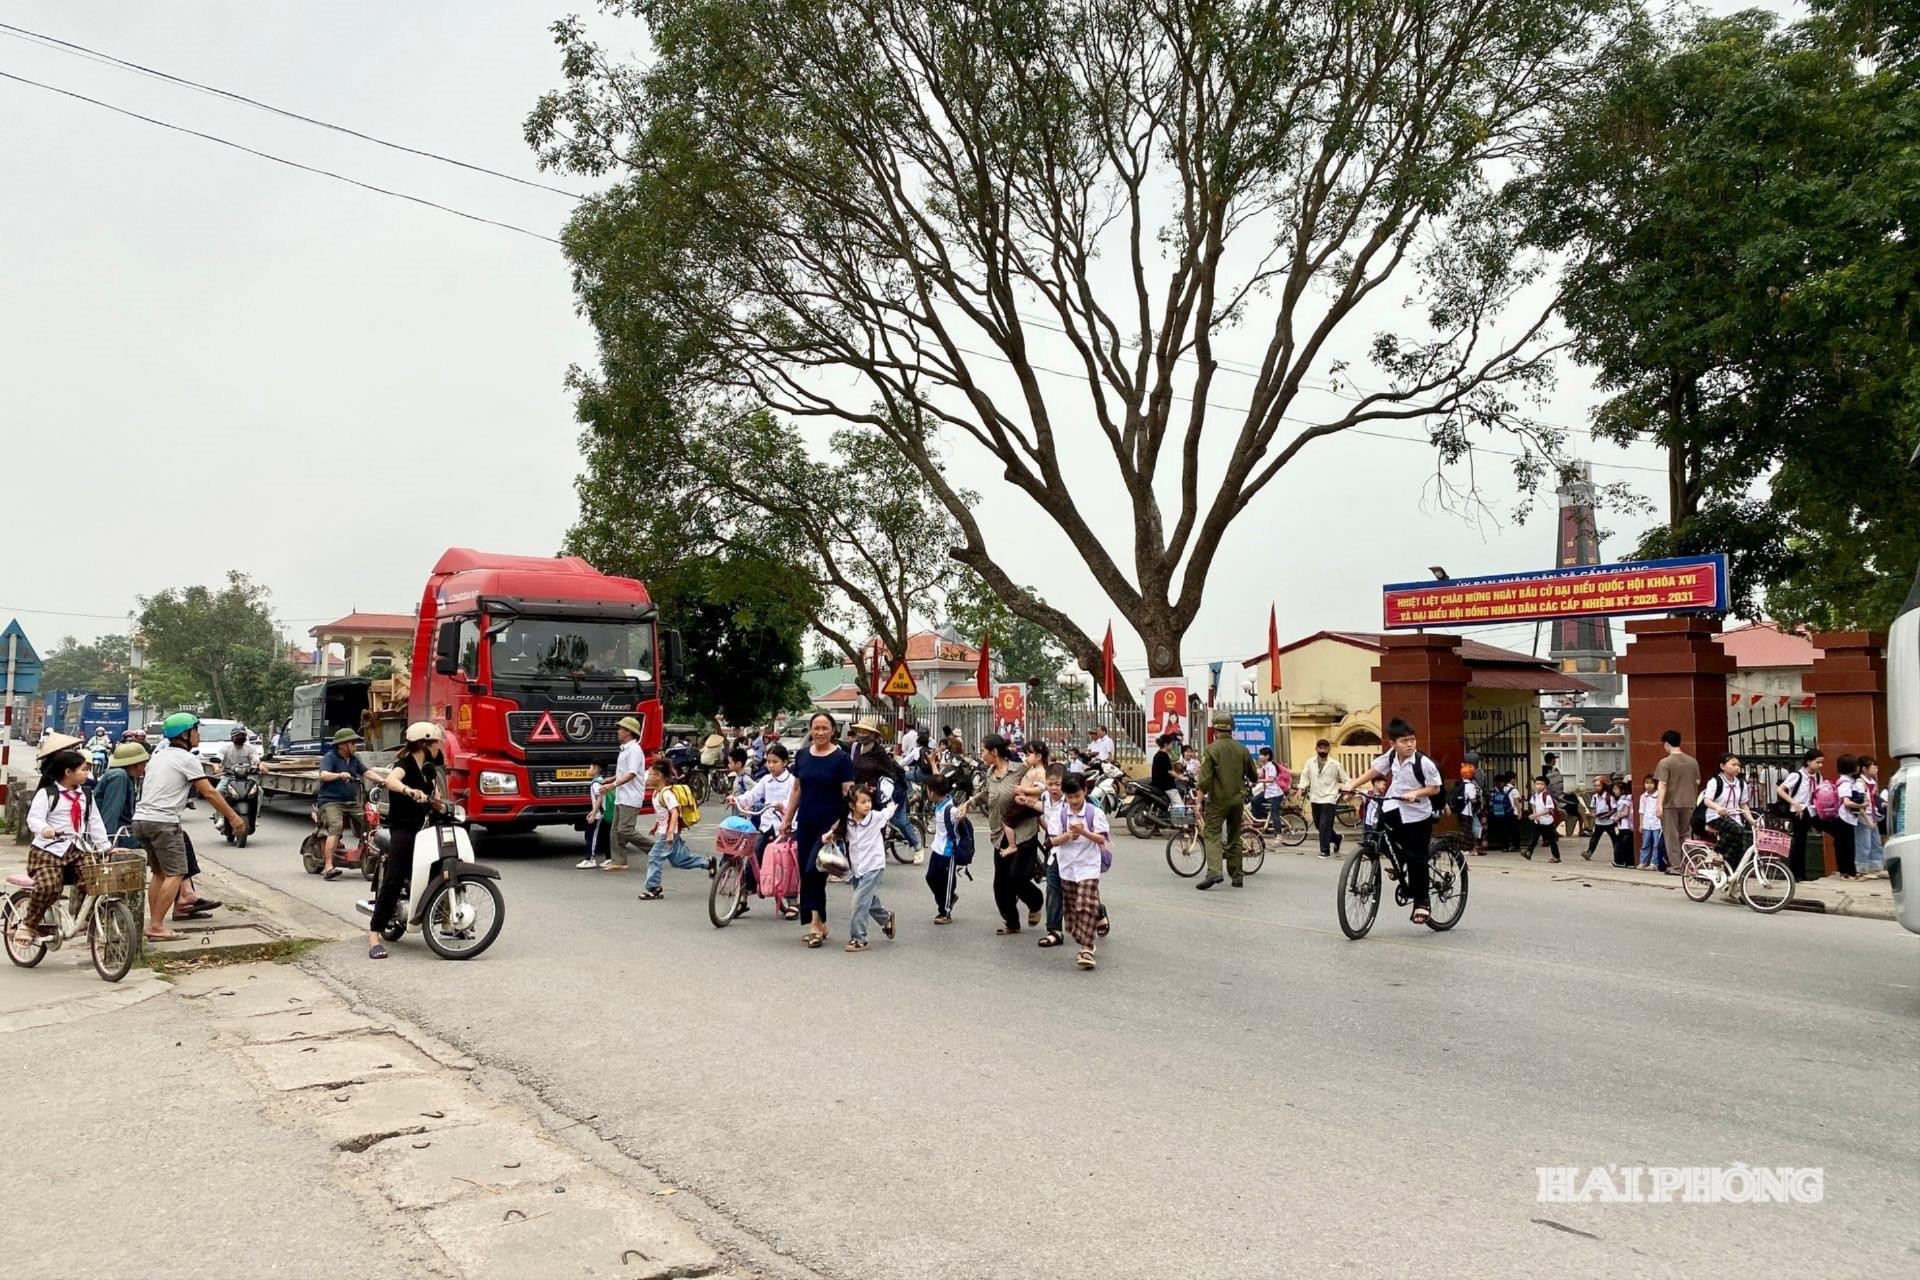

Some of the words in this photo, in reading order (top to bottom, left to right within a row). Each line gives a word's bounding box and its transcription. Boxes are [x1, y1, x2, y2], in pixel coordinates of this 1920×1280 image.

[1422, 595, 1439, 607] LIỆT
[1441, 592, 1463, 605] CHÀO
[1493, 588, 1517, 600] NGÀY
[1598, 577, 1625, 594] QUỐC
[1627, 576, 1645, 592] HỘI
[1647, 575, 1676, 589] KHÓA
[1678, 574, 1696, 585] XVI
[1539, 600, 1558, 612] CÁC
[1560, 596, 1580, 611] CẤP
[1582, 596, 1615, 610] NHIỆM
[1632, 593, 1658, 606] 2026
[1668, 591, 1693, 603] 2031
